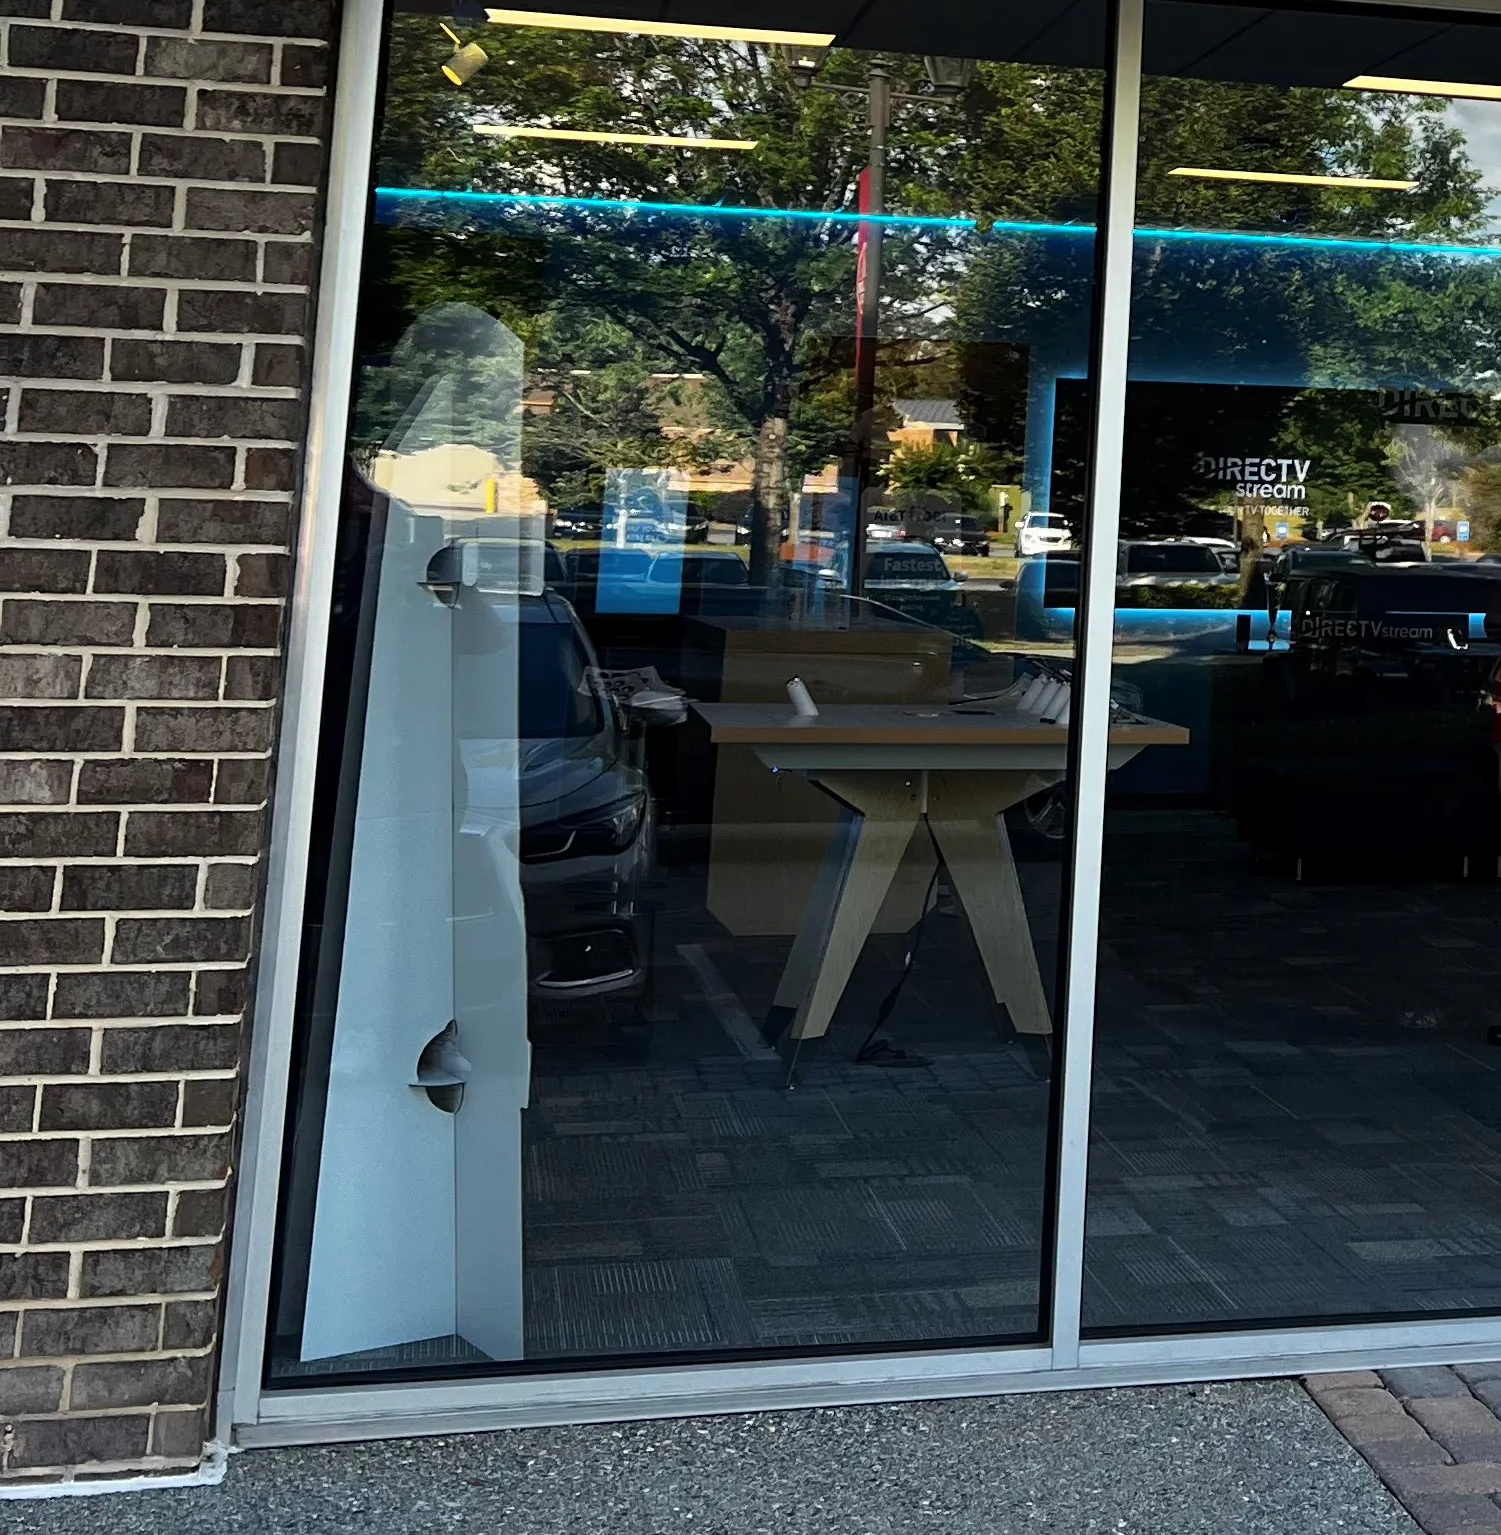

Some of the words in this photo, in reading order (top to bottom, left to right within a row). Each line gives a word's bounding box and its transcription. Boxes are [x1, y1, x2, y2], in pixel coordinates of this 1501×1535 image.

[1198, 457, 1311, 482] DIRECTV
[1236, 482, 1306, 499] stream
[884, 557, 942, 572] Fastest
